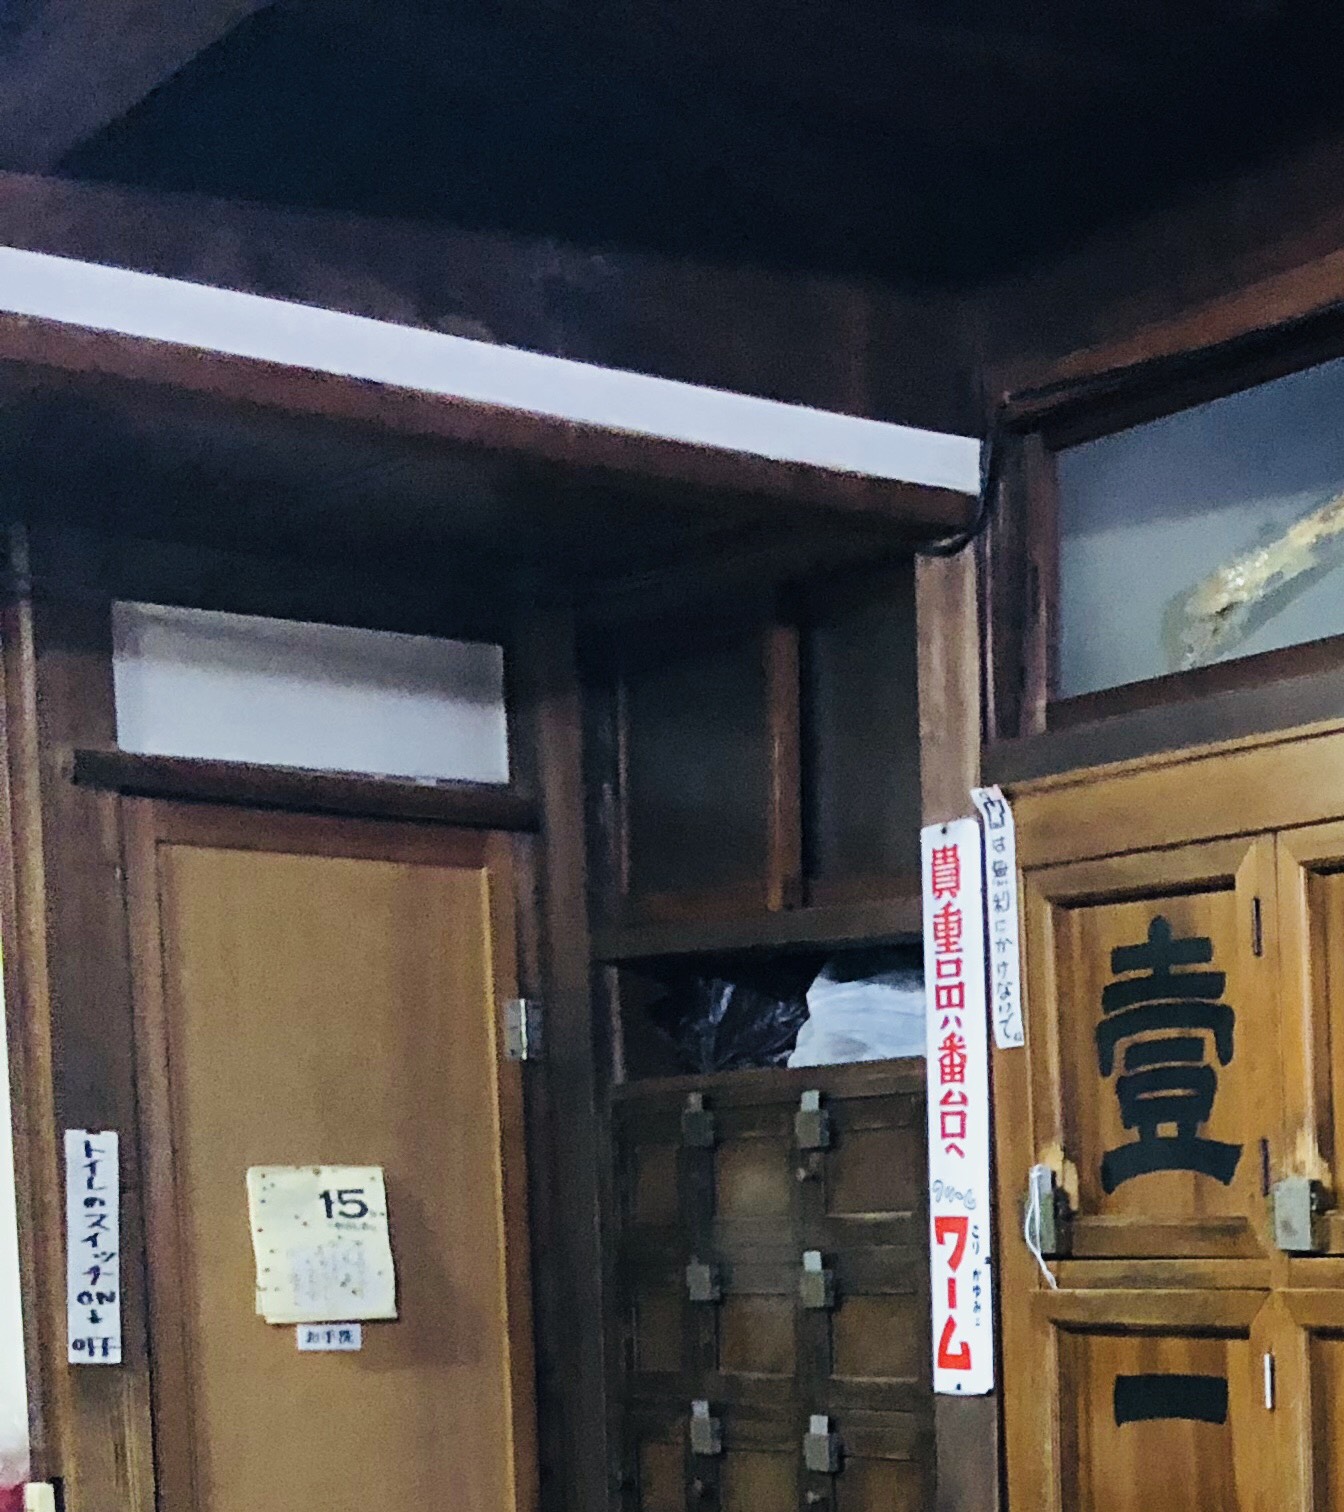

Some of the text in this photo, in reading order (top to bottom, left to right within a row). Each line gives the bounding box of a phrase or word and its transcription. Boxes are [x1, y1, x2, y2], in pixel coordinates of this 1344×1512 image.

[319, 1188, 369, 1220] 15
[934, 1216, 972, 1370] ワーム
